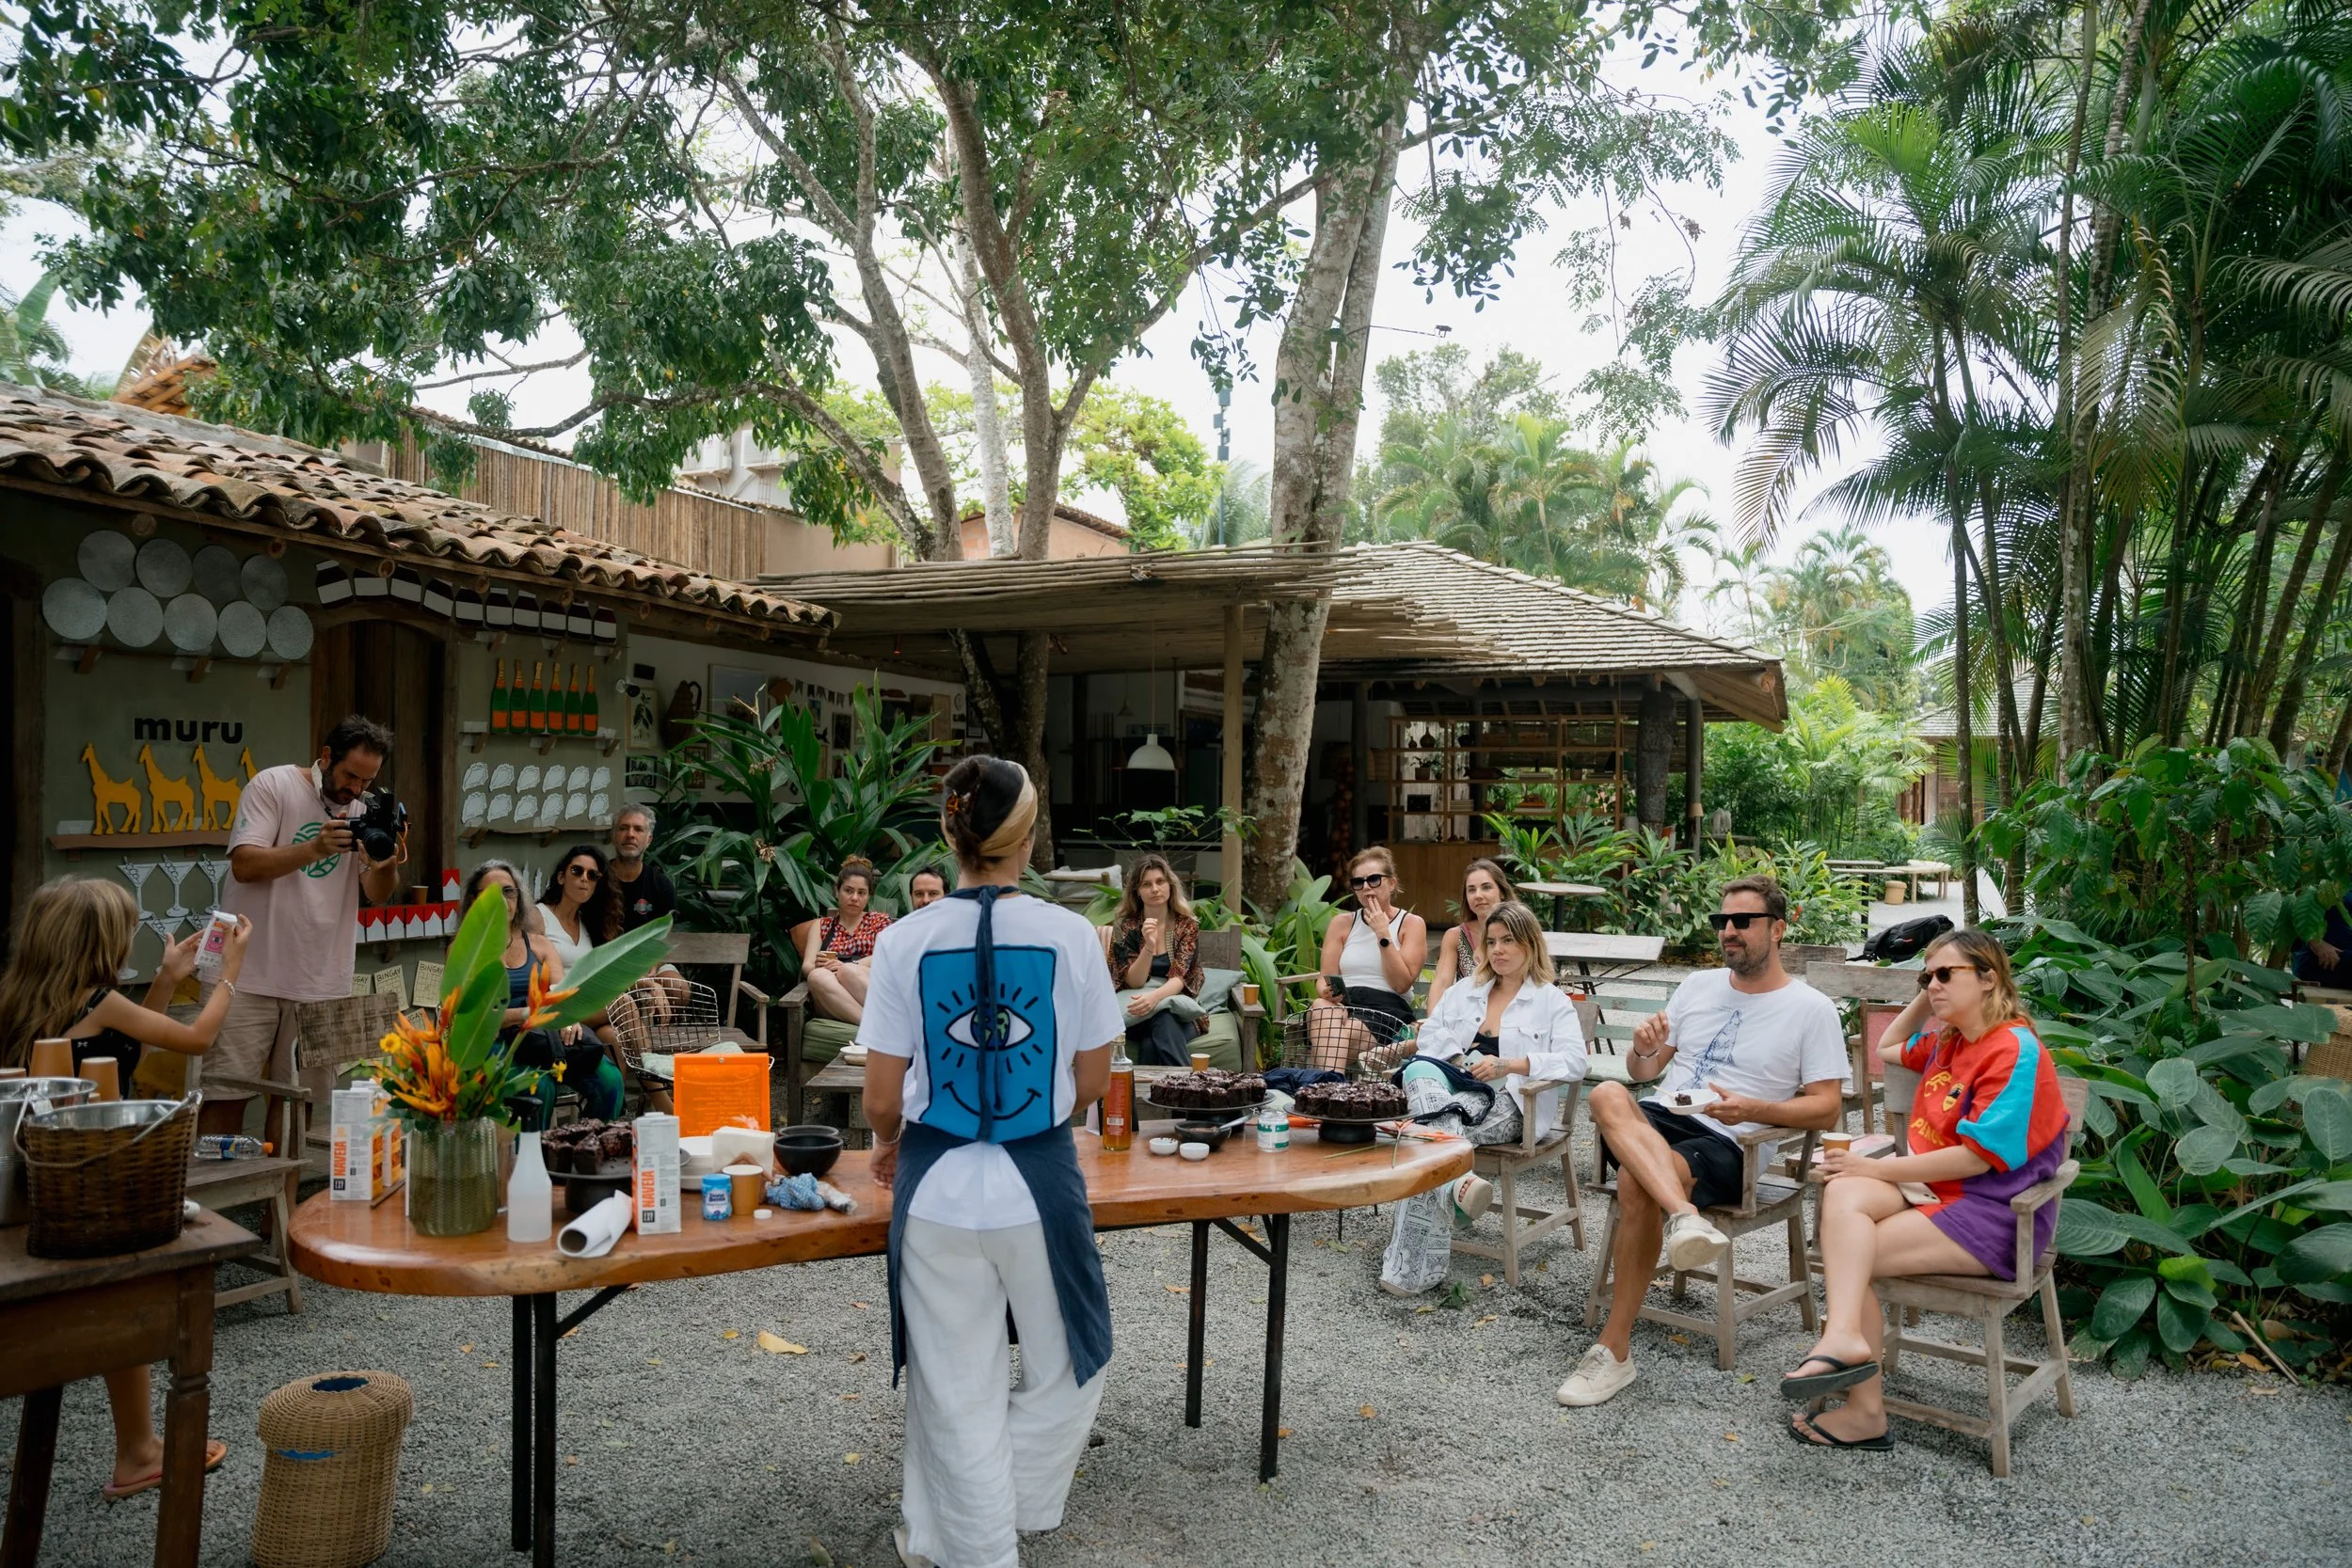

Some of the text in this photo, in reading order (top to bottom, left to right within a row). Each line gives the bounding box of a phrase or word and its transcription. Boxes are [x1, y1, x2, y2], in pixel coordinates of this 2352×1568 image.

[134, 718, 243, 744] muru
[352, 975, 368, 984] NGAY
[376, 968, 401, 982] BINGAY
[334, 1141, 347, 1176] NAVEIA
[641, 1170, 655, 1209] NAVEIA
